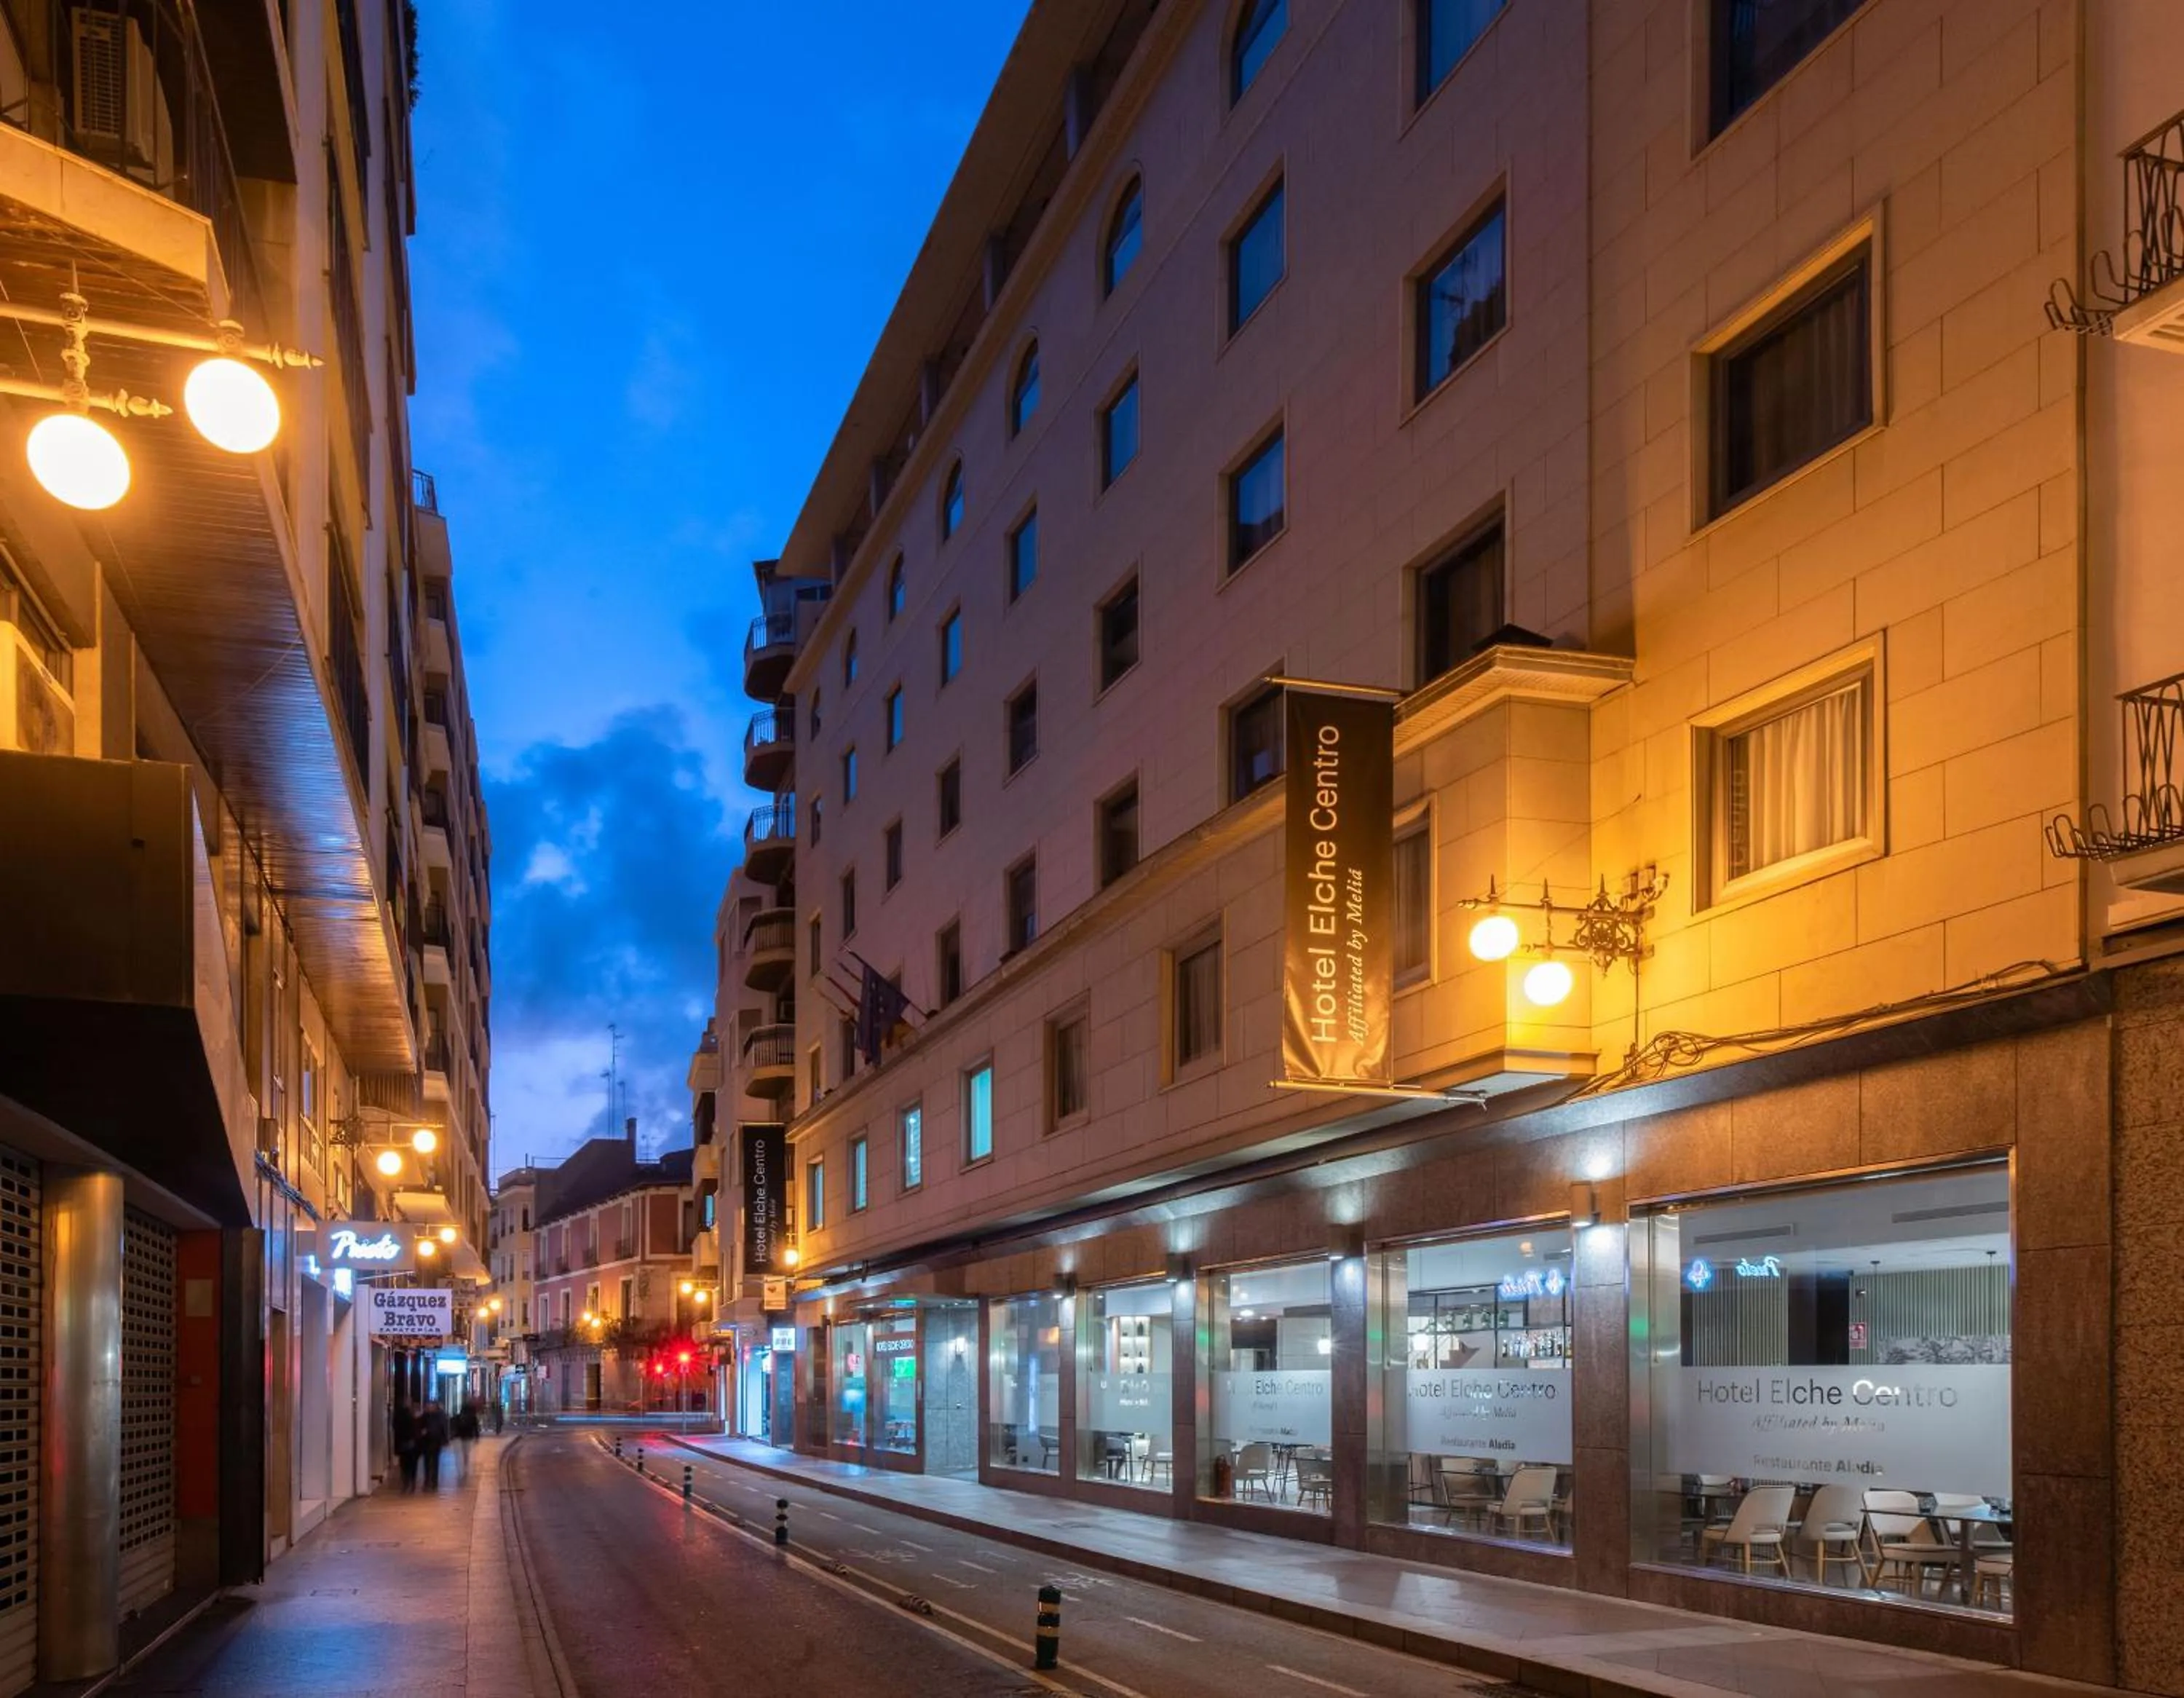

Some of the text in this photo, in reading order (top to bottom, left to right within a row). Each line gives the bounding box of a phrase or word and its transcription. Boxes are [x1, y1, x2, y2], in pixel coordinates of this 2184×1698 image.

[1307, 725, 1340, 1043] Hotel Elche Centro
[1346, 929, 1368, 950] by
[1347, 954, 1369, 1048] Affiliated
[753, 1139, 767, 1263] Hotel Elche Centro
[374, 1291, 446, 1311] Gázquez
[384, 1311, 436, 1326] Bravo
[1451, 1379, 1492, 1399] Elche
[1698, 1378, 1958, 1407] Hotel Elche Centro
